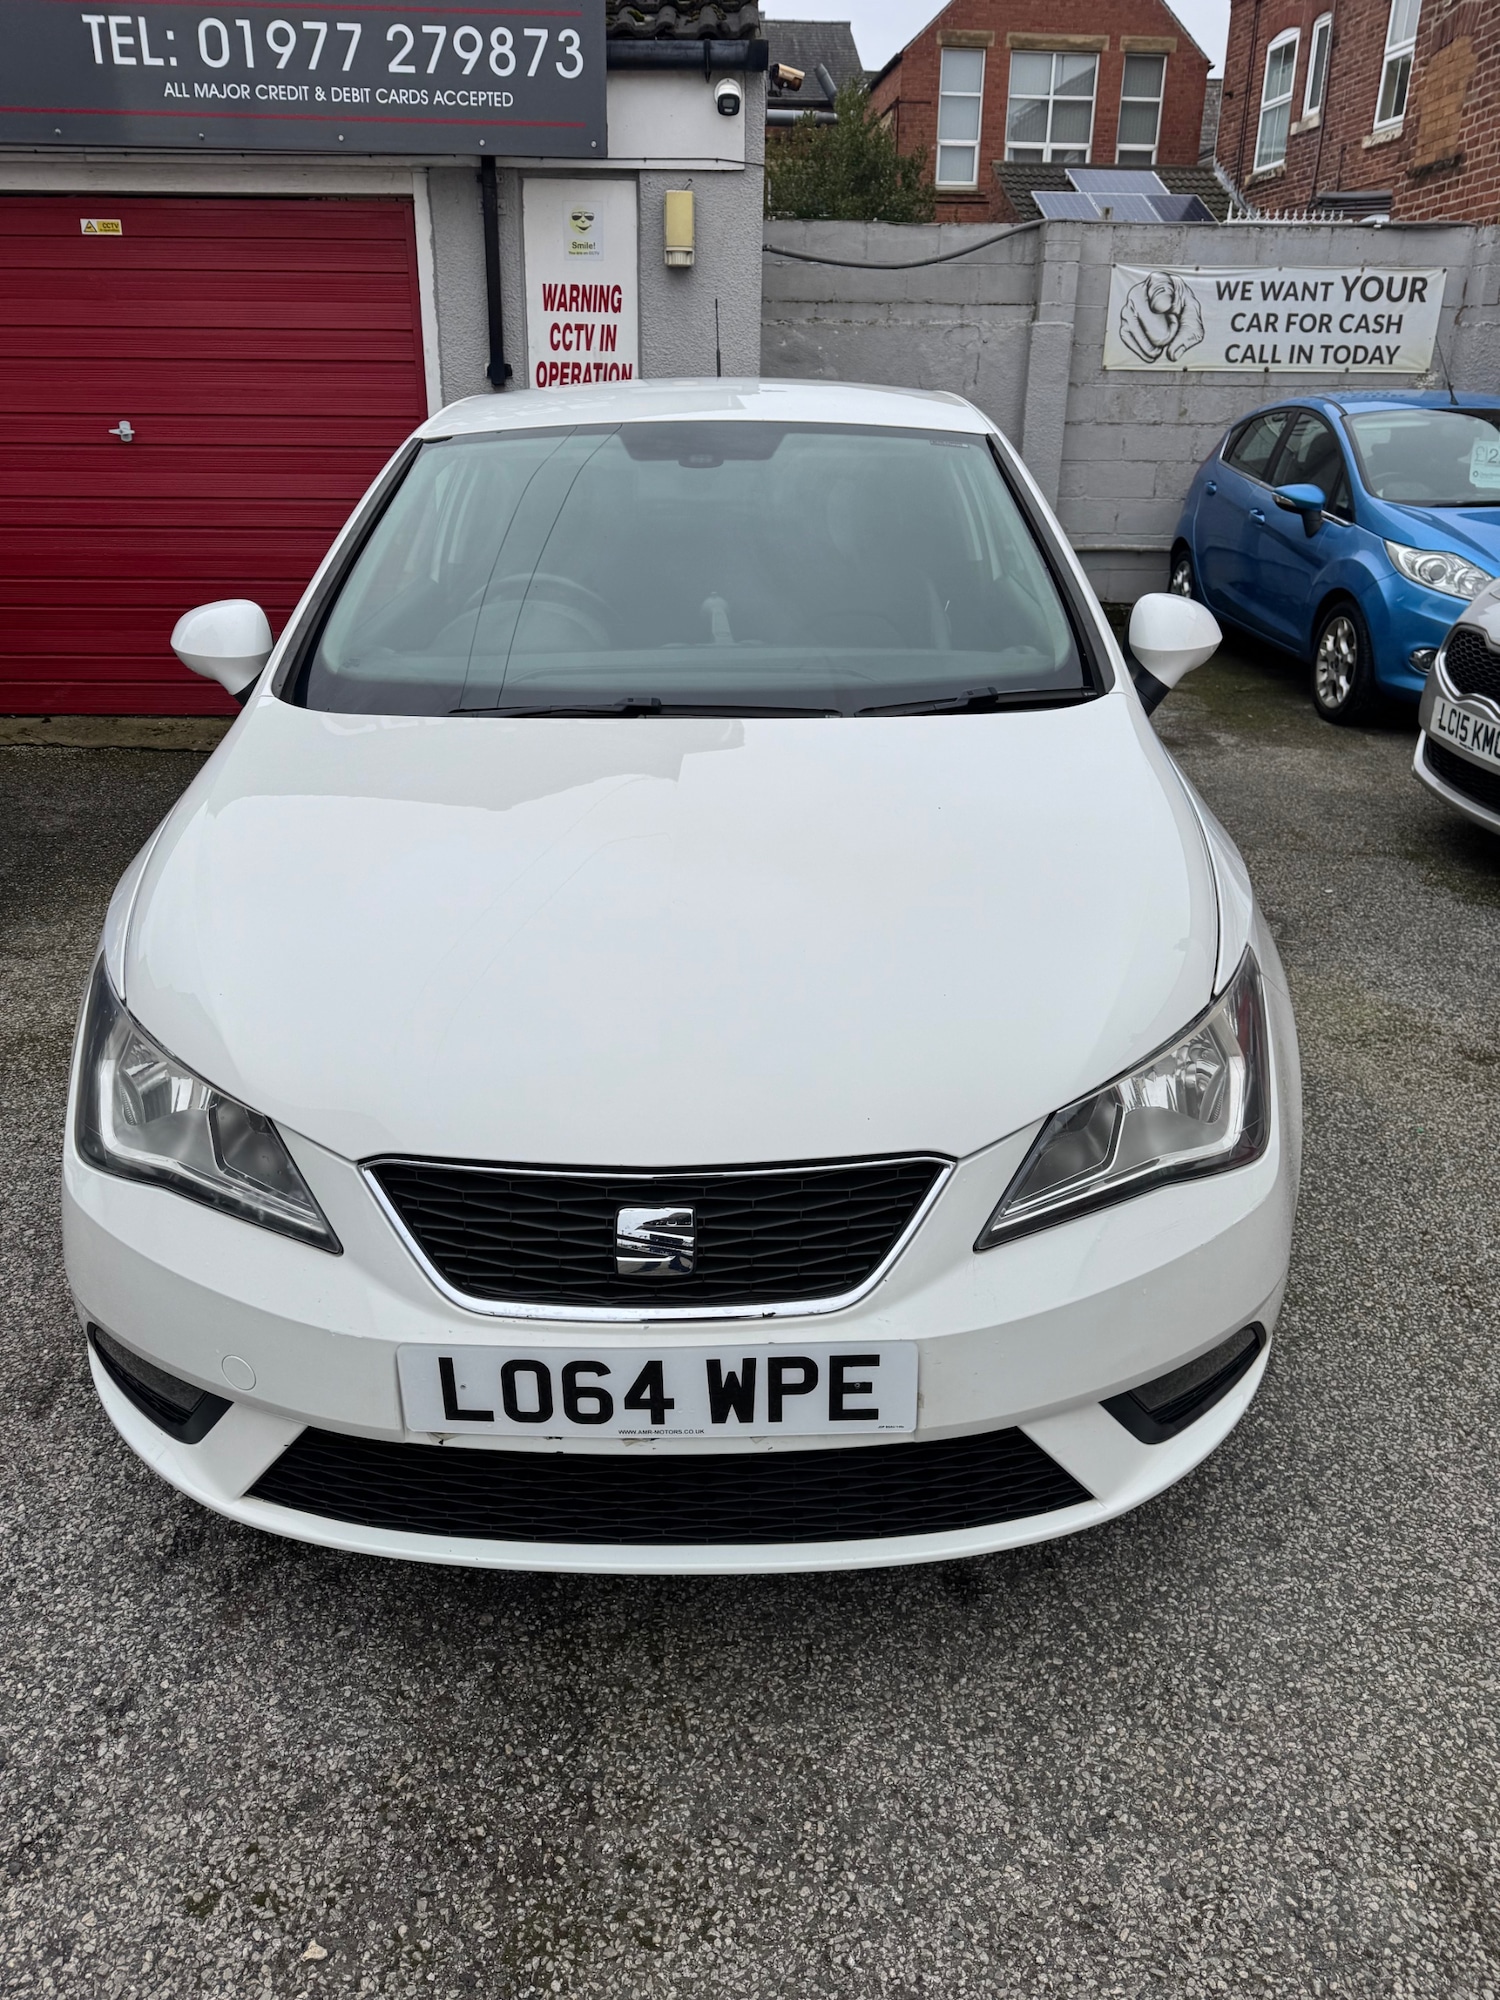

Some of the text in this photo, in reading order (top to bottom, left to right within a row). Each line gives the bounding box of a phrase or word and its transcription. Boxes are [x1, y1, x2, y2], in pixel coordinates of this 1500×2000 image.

[81, 14, 584, 79] TEL: 01977 279873
[164, 82, 514, 107] ALL MAJOR CREDIT & DEBIT CARDS ACCEPTED
[571, 241, 596, 250] Smile!
[542, 283, 622, 313] WARNING
[1216, 275, 1428, 303] WE WANT YOUR
[549, 322, 617, 352] CCTV IN
[1230, 312, 1403, 334] CAR FOR CASH
[1224, 343, 1401, 365] CALL IN TODAY
[536, 361, 633, 388] OPERATION
[1438, 703, 1470, 742] LC15
[438, 1354, 880, 1425] LO64 WPE
